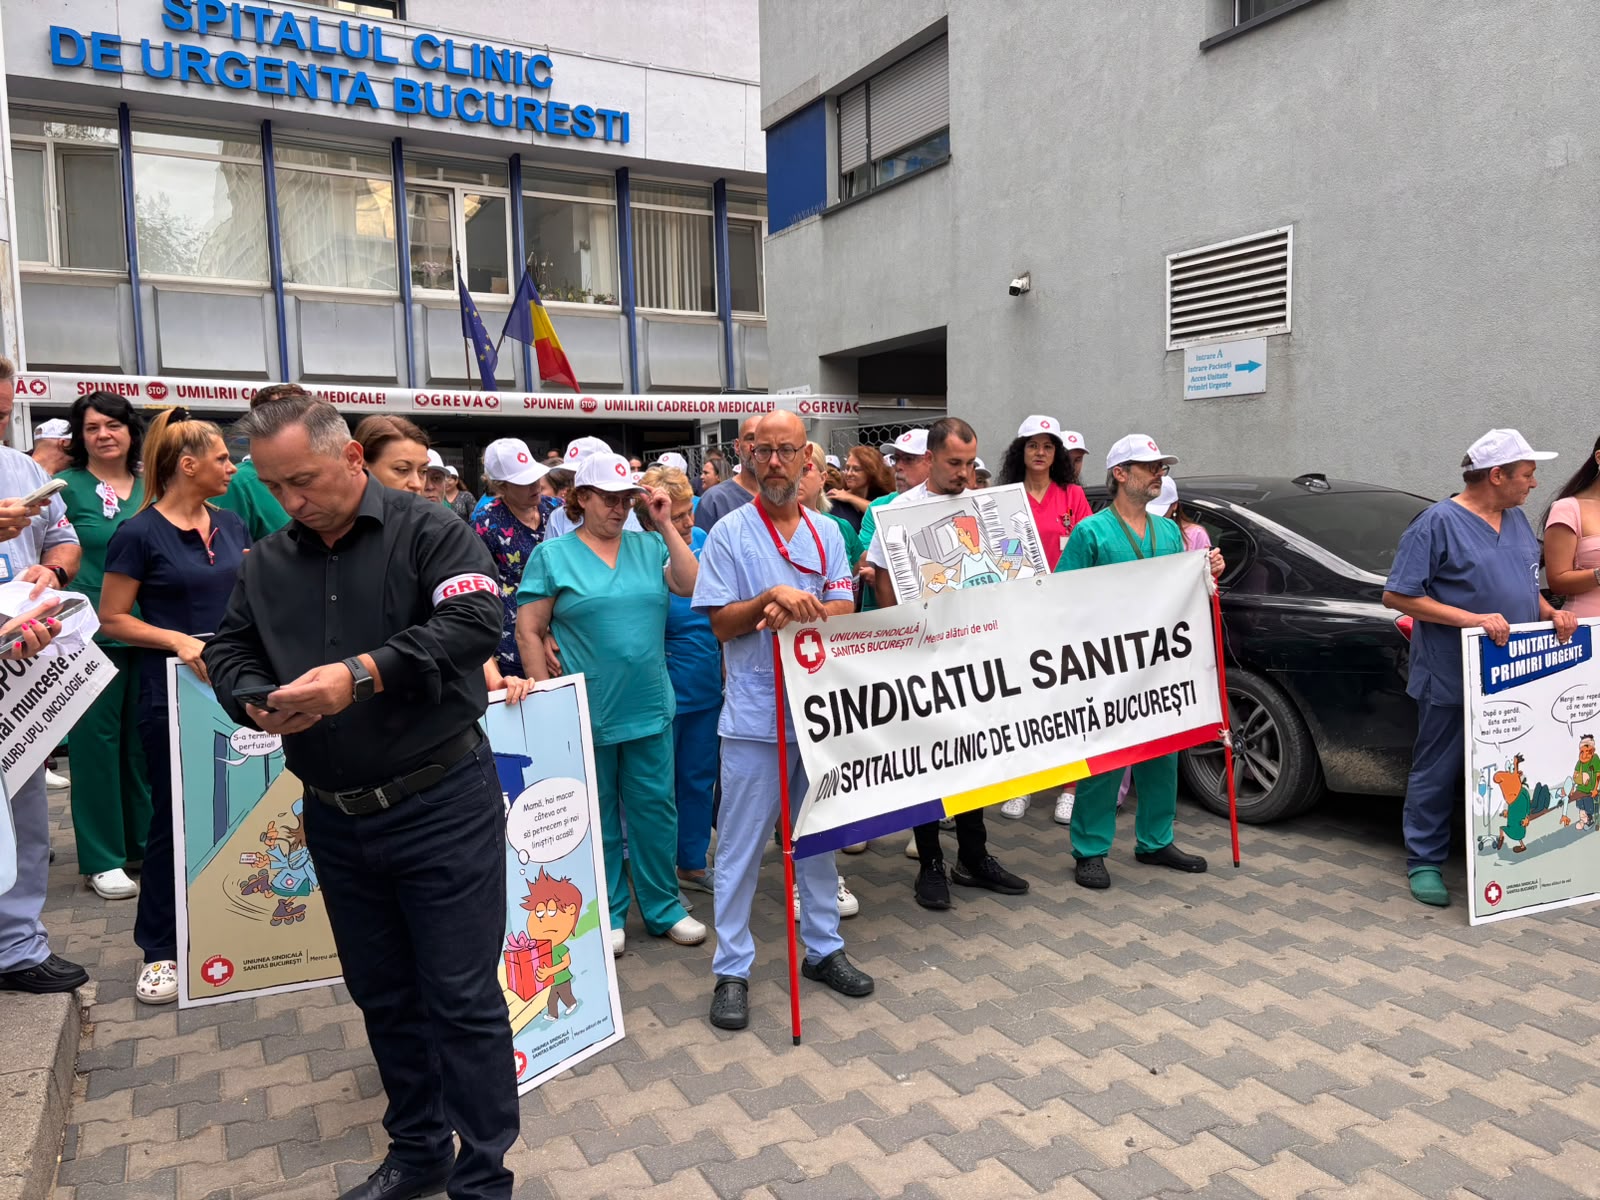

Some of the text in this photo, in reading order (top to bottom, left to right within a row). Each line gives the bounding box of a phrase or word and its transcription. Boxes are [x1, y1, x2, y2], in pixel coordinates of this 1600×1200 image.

[162, 0, 553, 89] SPITALUL CLINIC
[50, 25, 630, 144] DE URGENTA BUCURESTI
[147, 386, 166, 395] STOP
[177, 385, 237, 400] UMILIRII
[523, 397, 775, 413] SPUNEM STOP UMILIRII CADRELOR MEDICALE!
[443, 578, 499, 599] GREV
[829, 629, 872, 643] UNIUNEA
[873, 622, 920, 639] SINDICALĂ
[945, 624, 969, 639] alături
[970, 622, 982, 634] de
[983, 619, 998, 631] voi!
[831, 643, 866, 658] SANITAS
[1491, 655, 1543, 685] PRIMIRI
[804, 620, 1193, 743] SINDICATUL SANITAS
[42, 672, 89, 723] ONCOLOGIE,
[84, 660, 100, 676] etc.
[233, 734, 247, 742] S-a
[816, 764, 840, 802] DIN
[840, 745, 928, 793] SPITALUL
[931, 731, 988, 771] CLINIC
[989, 725, 1013, 757] DE
[556, 806, 568, 815] ore
[532, 820, 563, 838] petrecem
[243, 956, 270, 965] UNIUNEA
[243, 963, 269, 972] SANITAS
